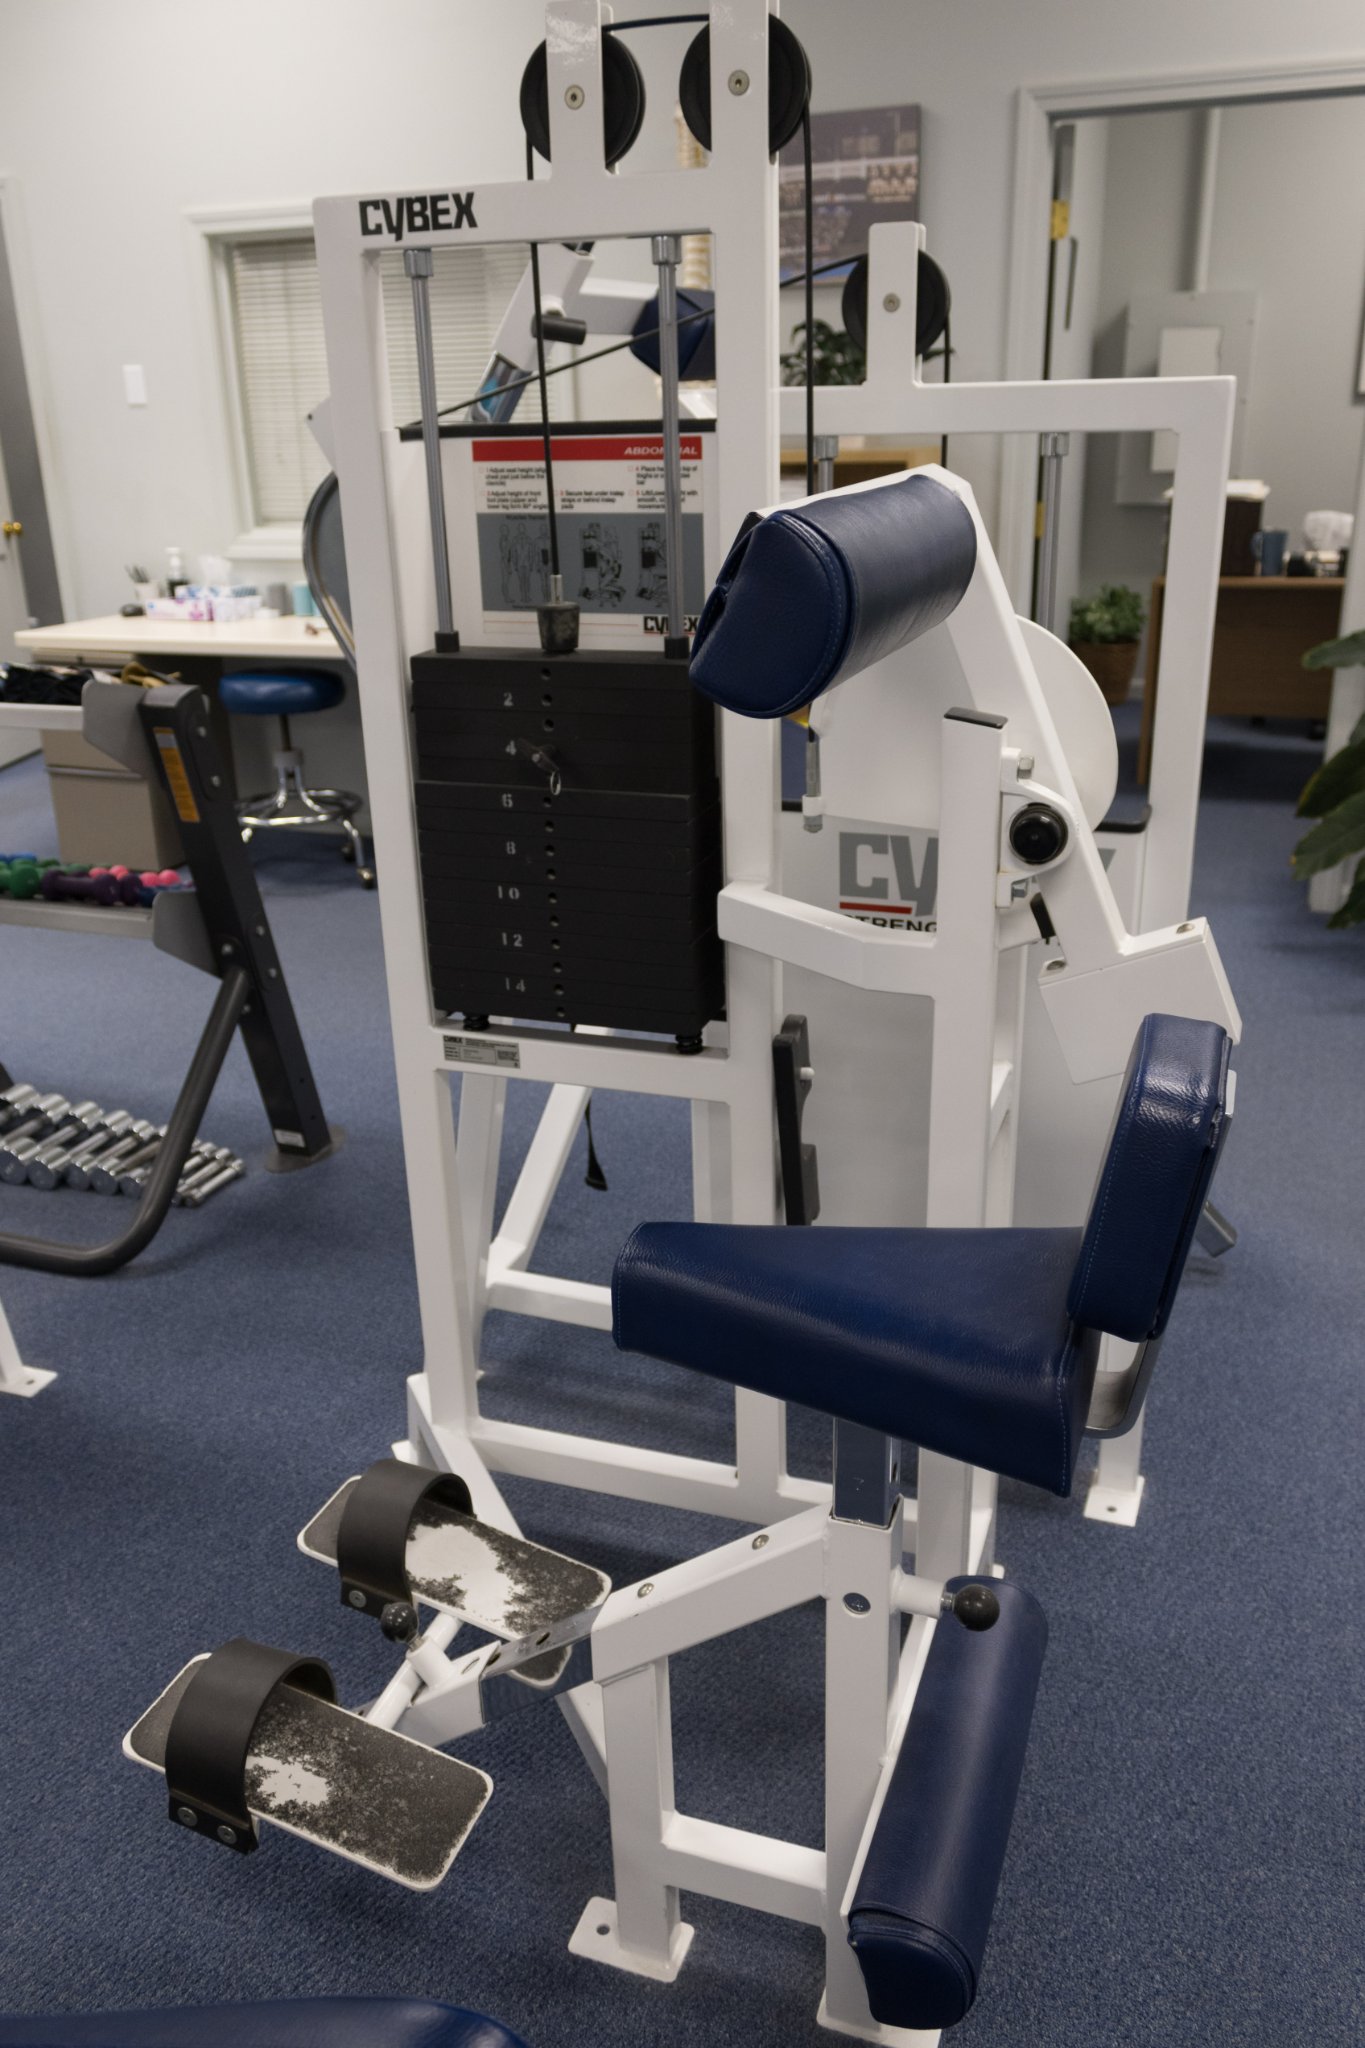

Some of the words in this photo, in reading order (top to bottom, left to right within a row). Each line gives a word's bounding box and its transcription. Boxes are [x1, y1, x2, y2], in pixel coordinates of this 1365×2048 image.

[358, 191, 478, 242] CYBEX
[624, 446, 698, 456] ABDOAL
[504, 692, 514, 706] 2
[505, 740, 516, 756] 4
[506, 841, 516, 855] 8
[498, 885, 520, 900] 10
[845, 914, 937, 933] TRENG
[502, 932, 523, 948] 12
[506, 977, 526, 992] 14
